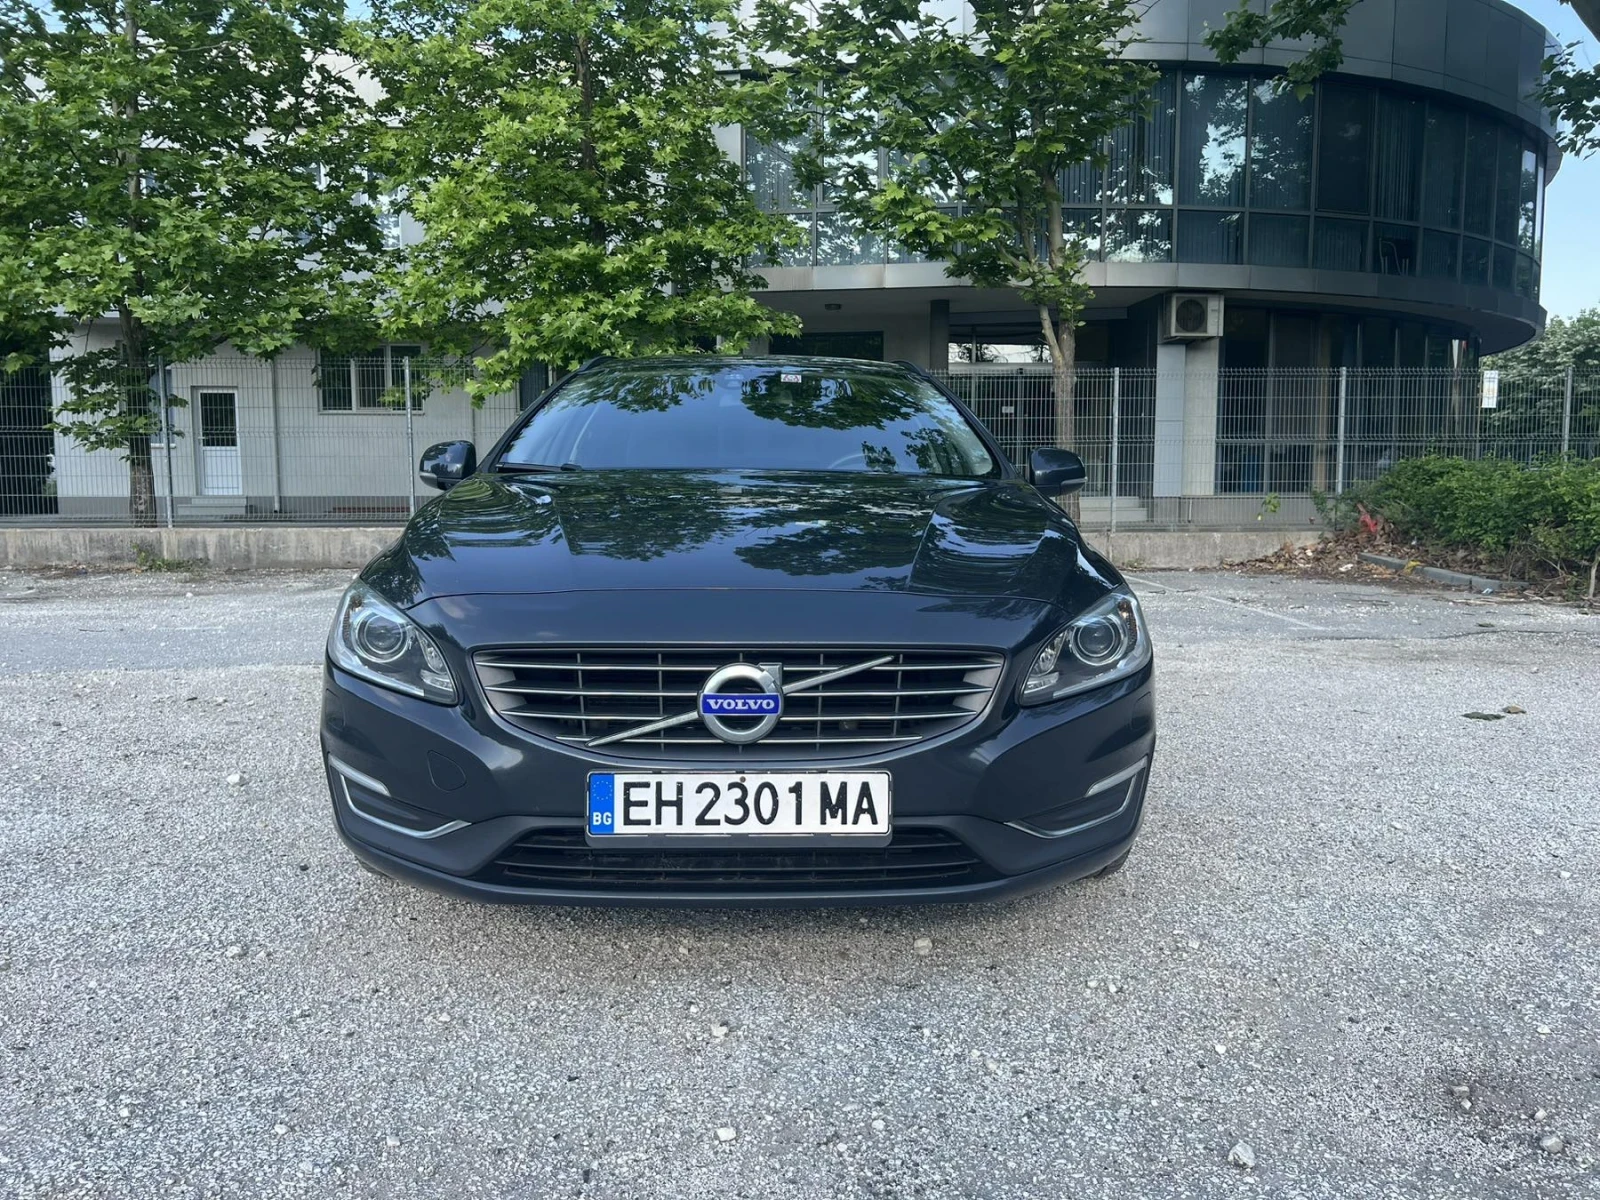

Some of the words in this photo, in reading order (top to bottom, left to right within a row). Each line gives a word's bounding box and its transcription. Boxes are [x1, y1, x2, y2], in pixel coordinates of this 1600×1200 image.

[706, 698, 775, 710] VOLVO
[622, 781, 684, 826] EH
[694, 781, 803, 826] 2301
[819, 781, 878, 826] MA
[592, 812, 613, 825] BG
